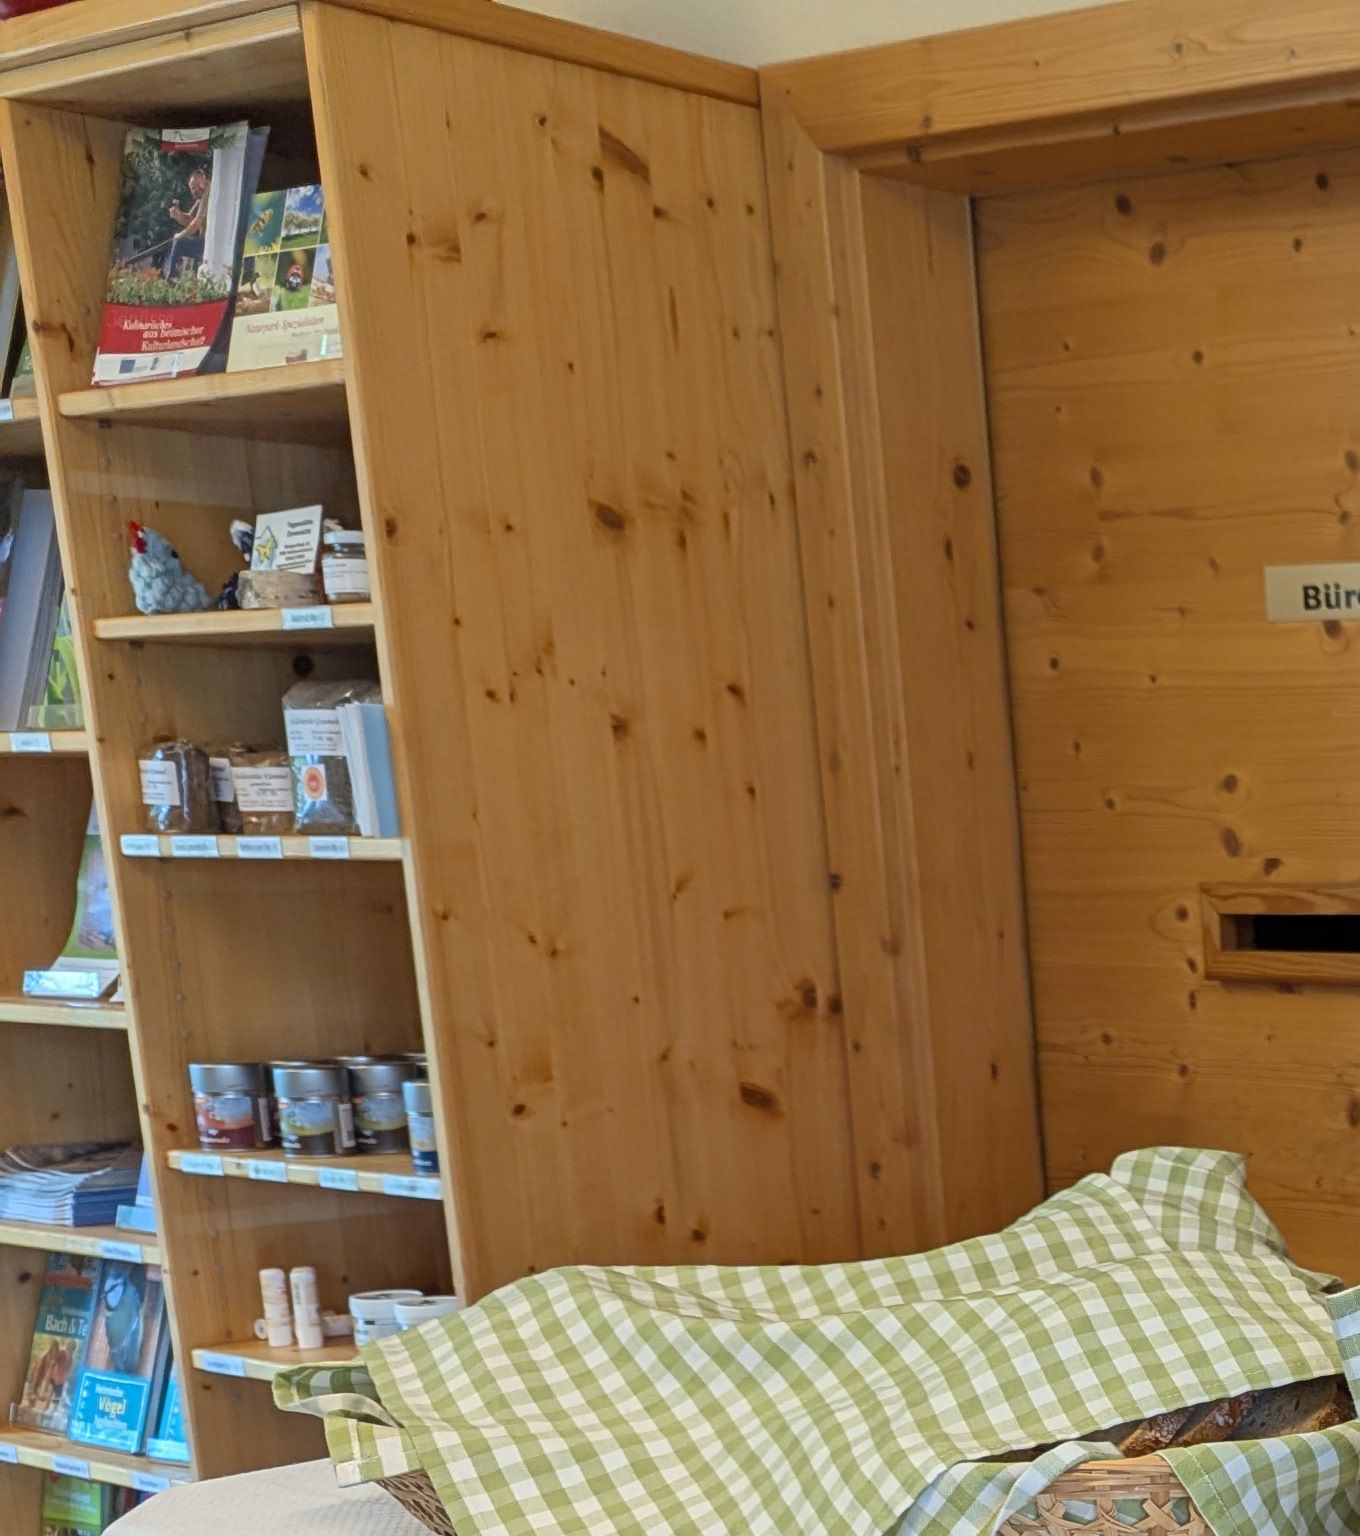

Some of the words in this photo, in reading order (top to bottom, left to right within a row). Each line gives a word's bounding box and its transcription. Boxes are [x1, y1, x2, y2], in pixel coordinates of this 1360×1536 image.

[143, 329, 159, 339] aus
[46, 1315, 68, 1333] Bach
[99, 1395, 127, 1418] Vögel
